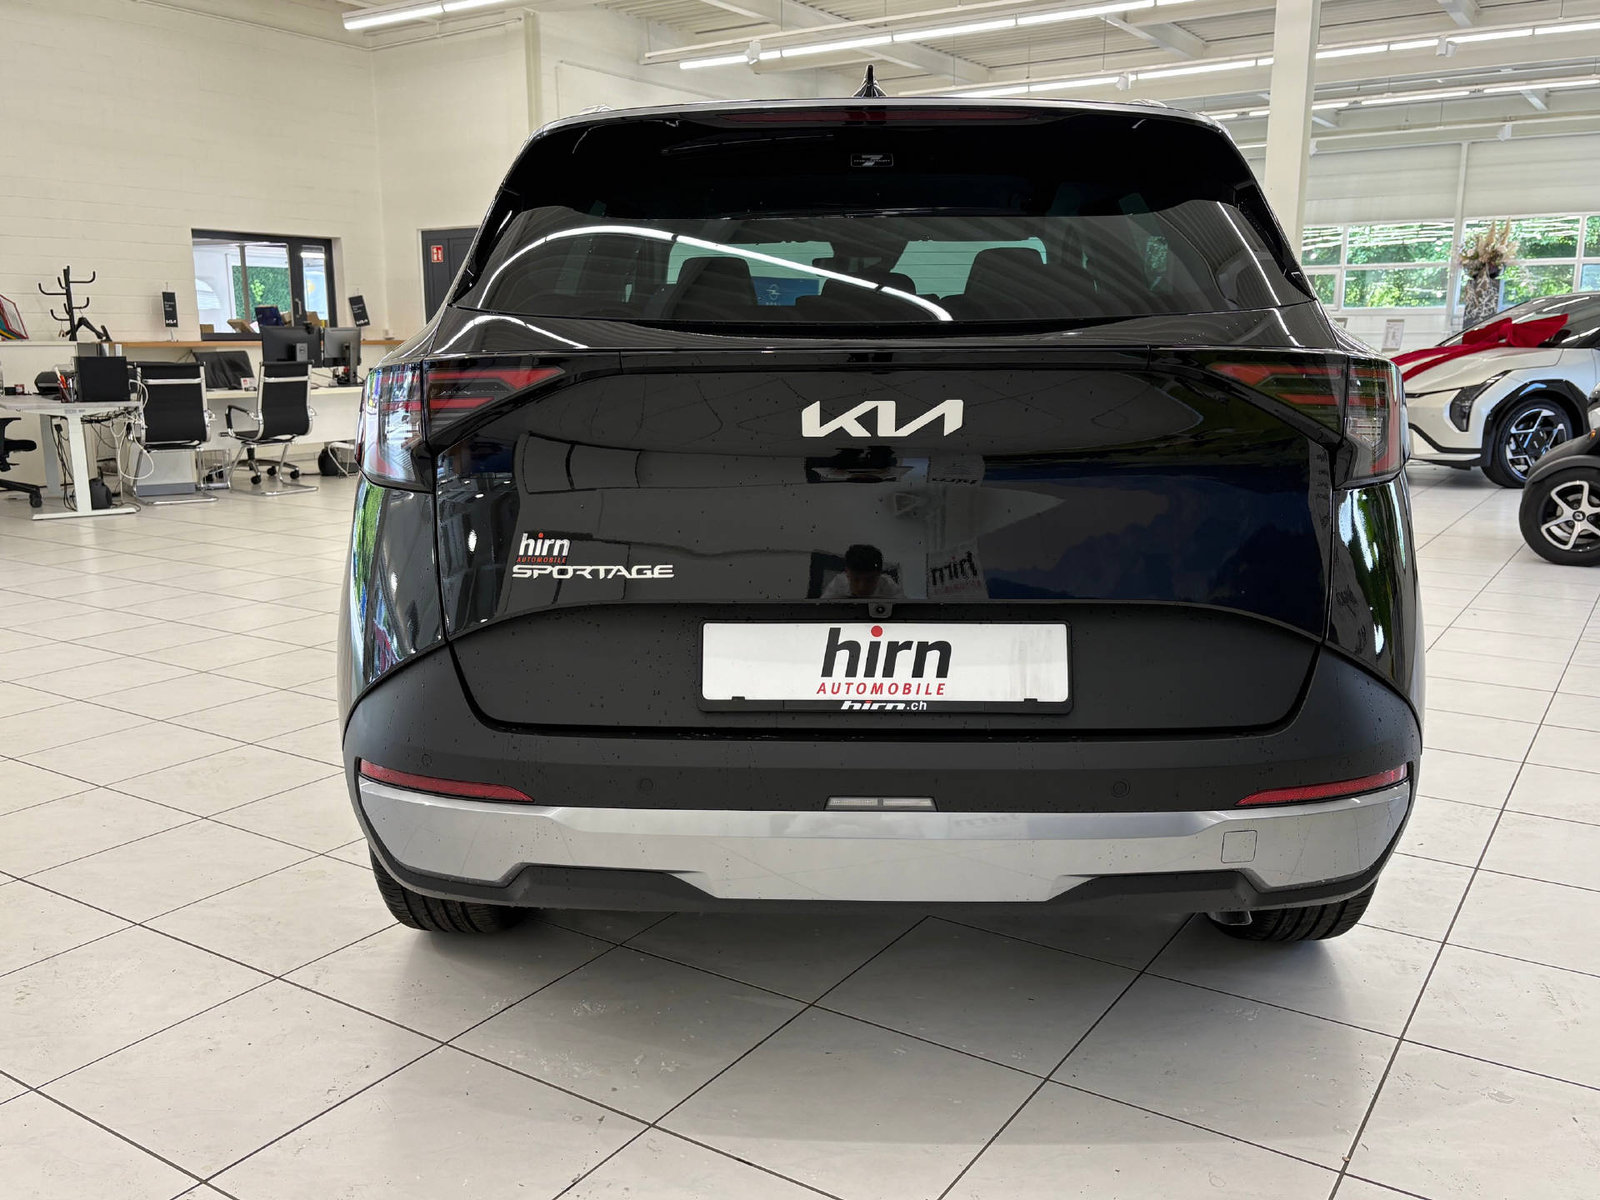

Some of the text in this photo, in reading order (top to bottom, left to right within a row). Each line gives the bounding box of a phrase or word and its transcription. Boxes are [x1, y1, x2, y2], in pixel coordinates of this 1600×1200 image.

[801, 399, 964, 437] KIA
[518, 532, 570, 556] hirn
[516, 556, 567, 564] AUTOMOBILE
[511, 564, 675, 579] SPORTAGE
[820, 625, 952, 678] hirn
[816, 682, 946, 696] AUTOMOBILE
[840, 700, 927, 711] hirn.ch
